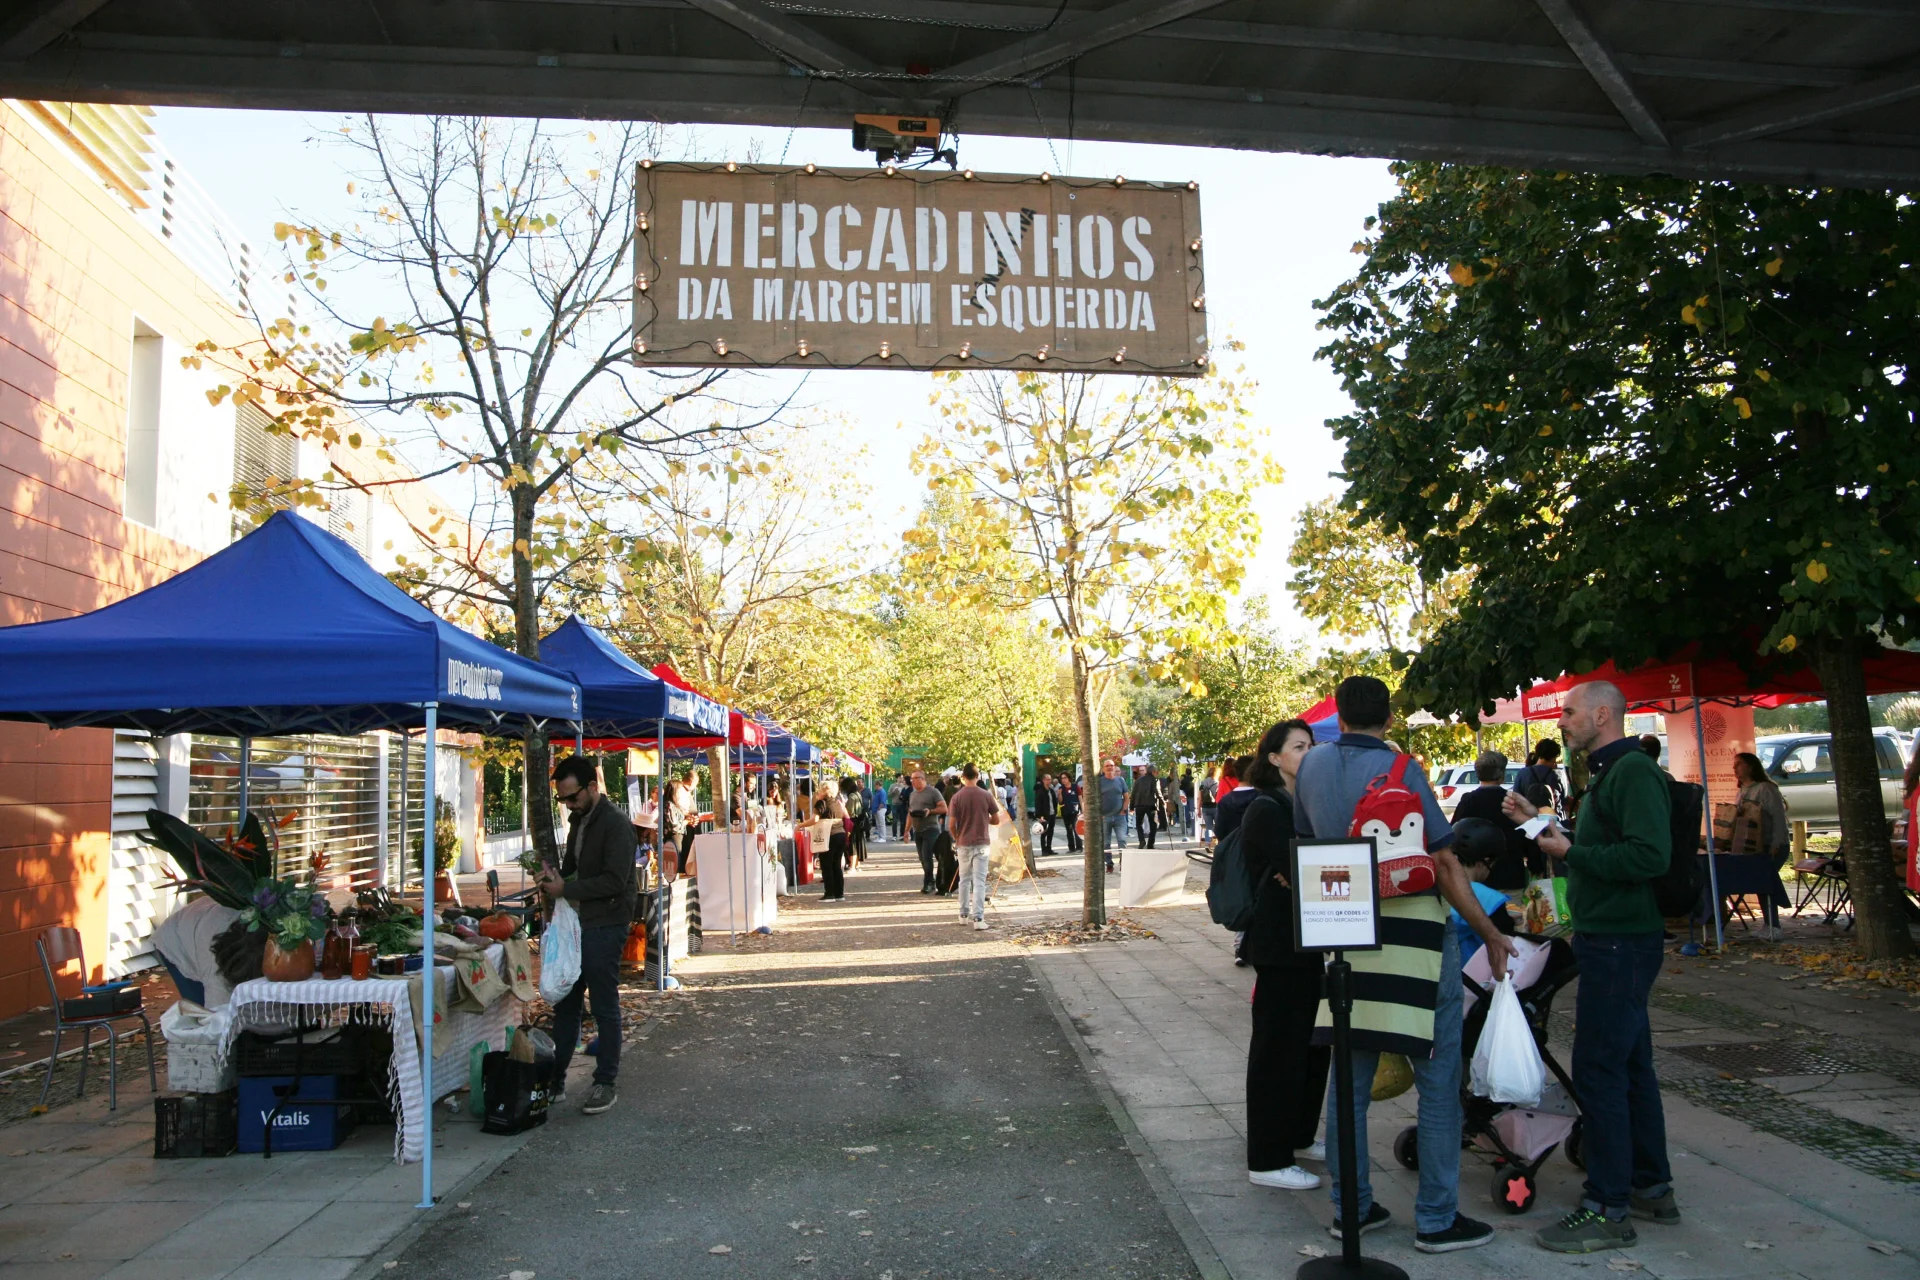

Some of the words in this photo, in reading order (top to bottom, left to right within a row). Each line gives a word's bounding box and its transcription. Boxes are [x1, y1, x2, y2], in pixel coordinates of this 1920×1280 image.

[680, 199, 1155, 282] MERCADINHOS
[677, 277, 733, 321] DA
[753, 279, 932, 325] MARGEM
[951, 284, 1156, 333] ESQUERDA
[1321, 881, 1350, 896] LAB
[261, 1108, 310, 1126] Vitalis
